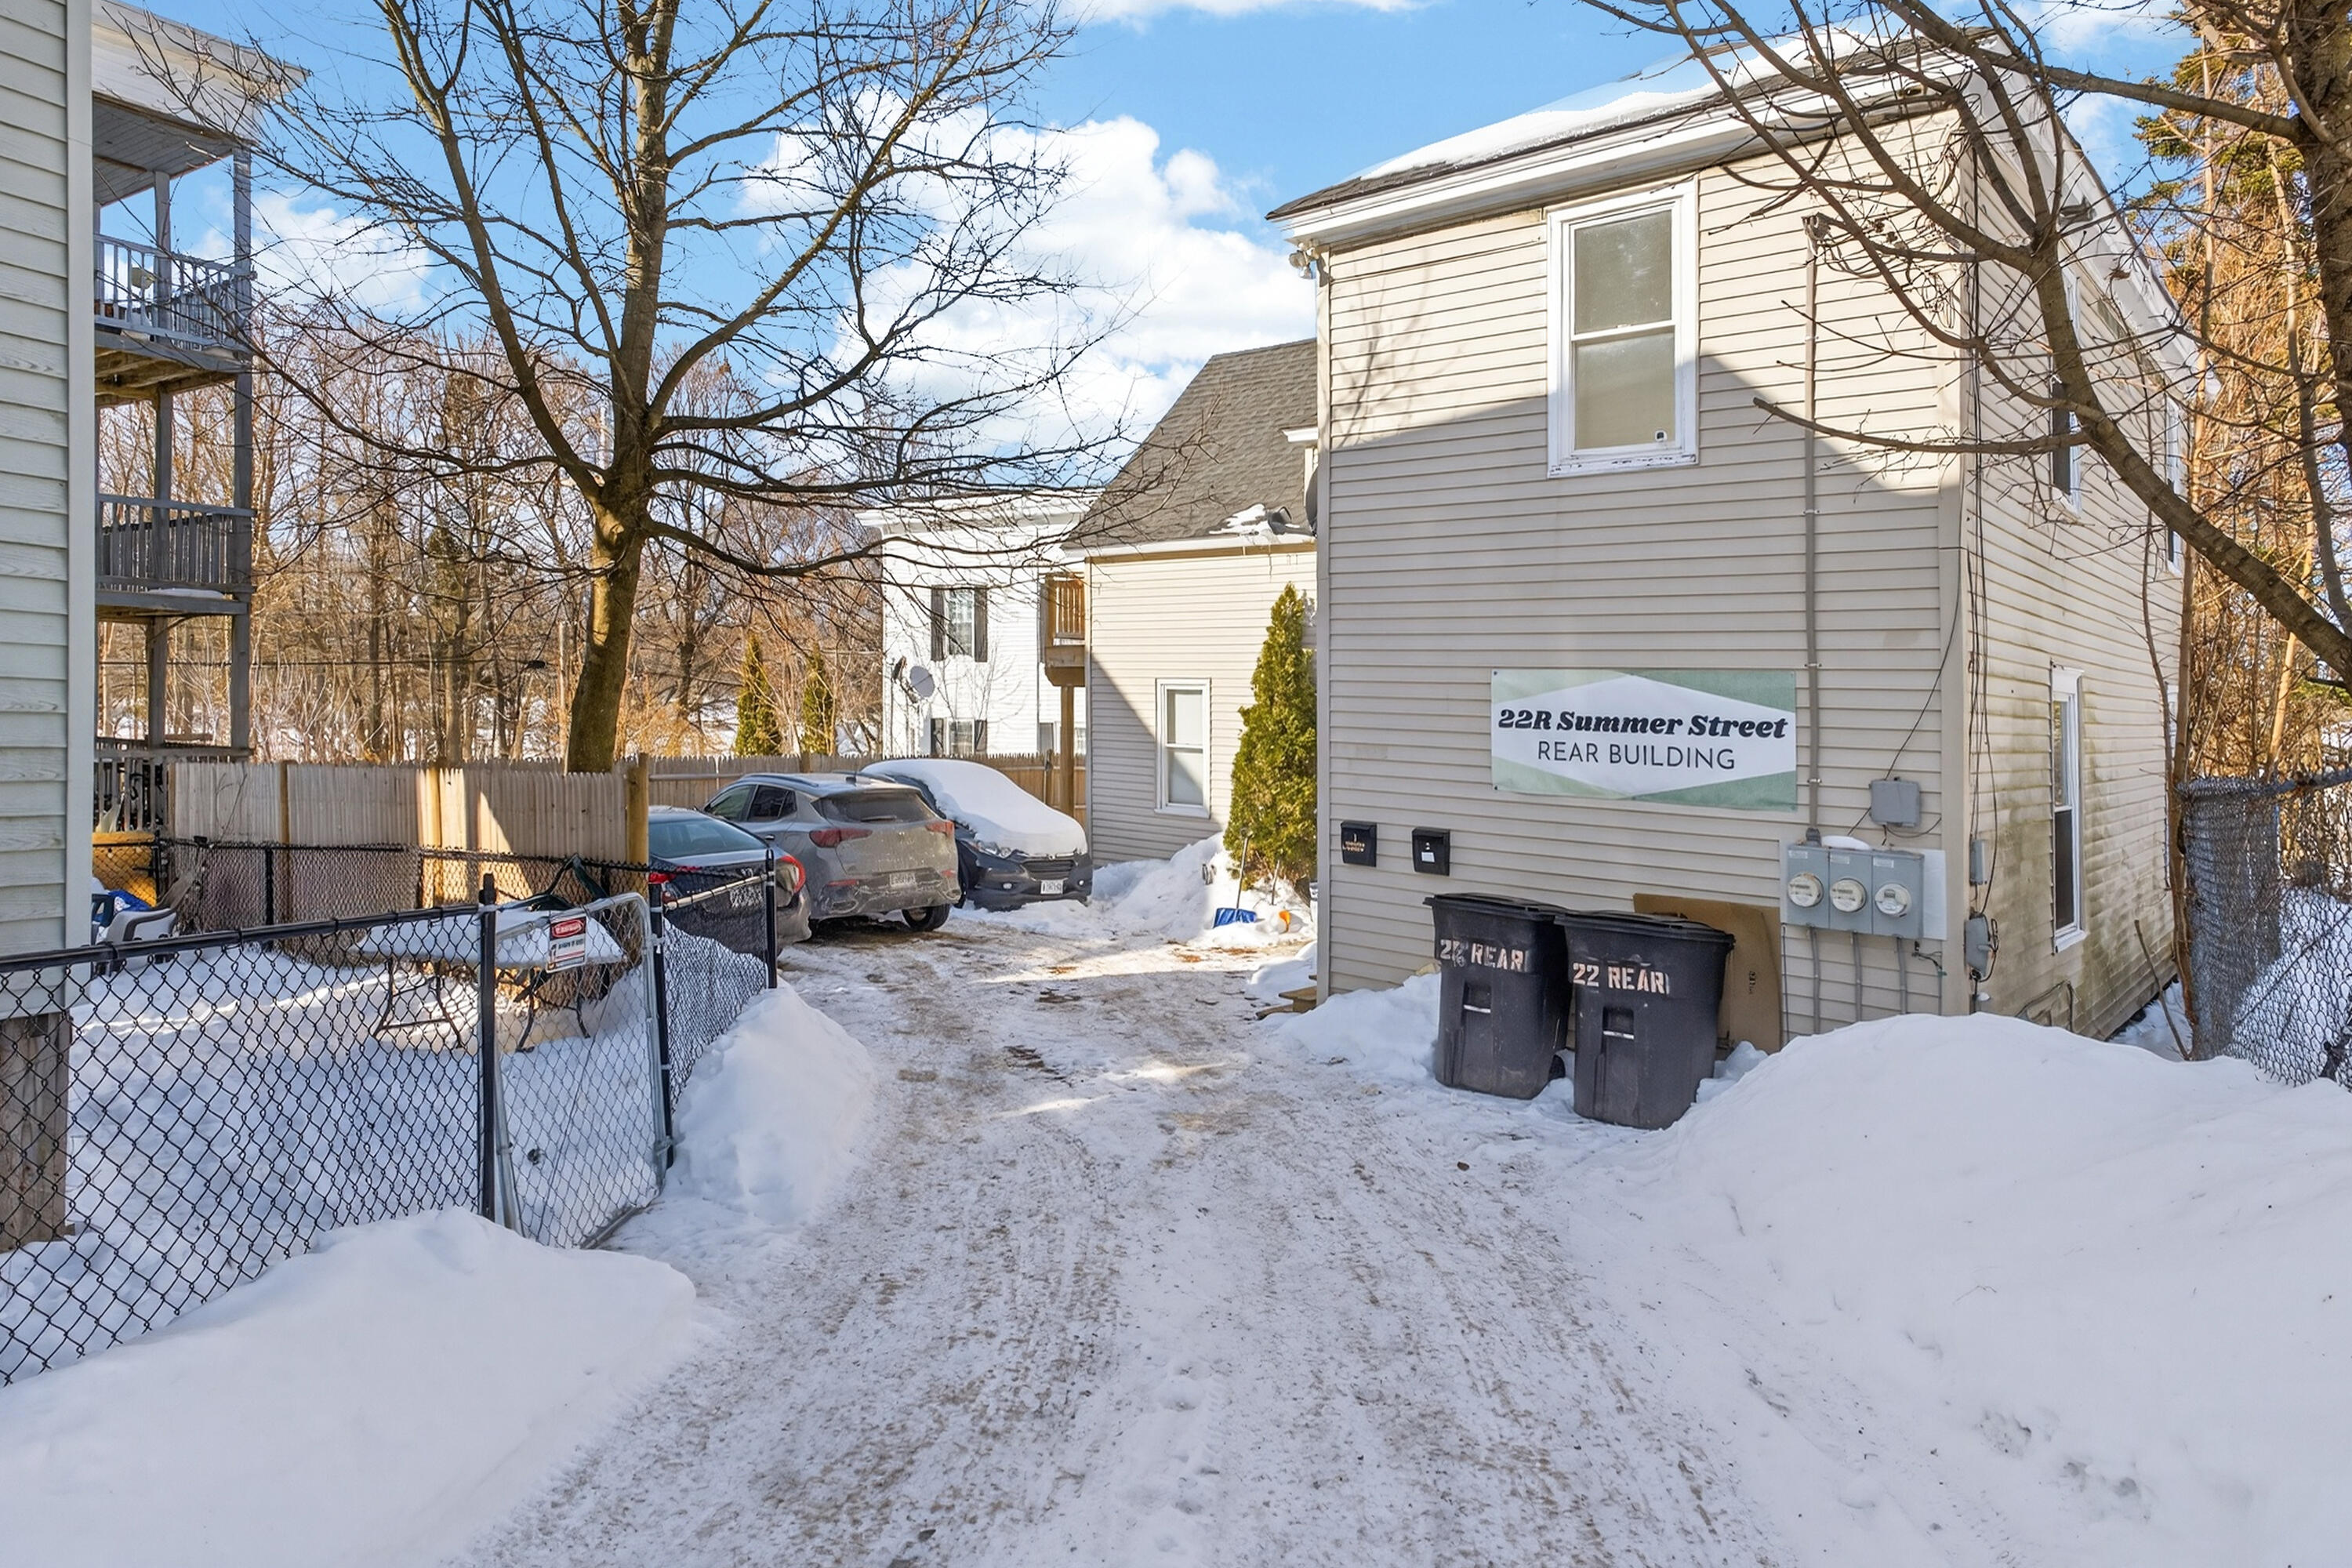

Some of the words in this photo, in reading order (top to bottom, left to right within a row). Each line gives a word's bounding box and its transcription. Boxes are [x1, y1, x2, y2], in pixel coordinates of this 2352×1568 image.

[1498, 709, 1552, 730] 22R
[1556, 710, 1683, 735] Summer
[1687, 715, 1788, 739] Street
[1537, 740, 1599, 763] REAR
[1609, 743, 1735, 770] BUILDING
[1471, 942, 1524, 972] REAR
[1573, 962, 1599, 987] 22
[1608, 966, 1665, 994] REAR
